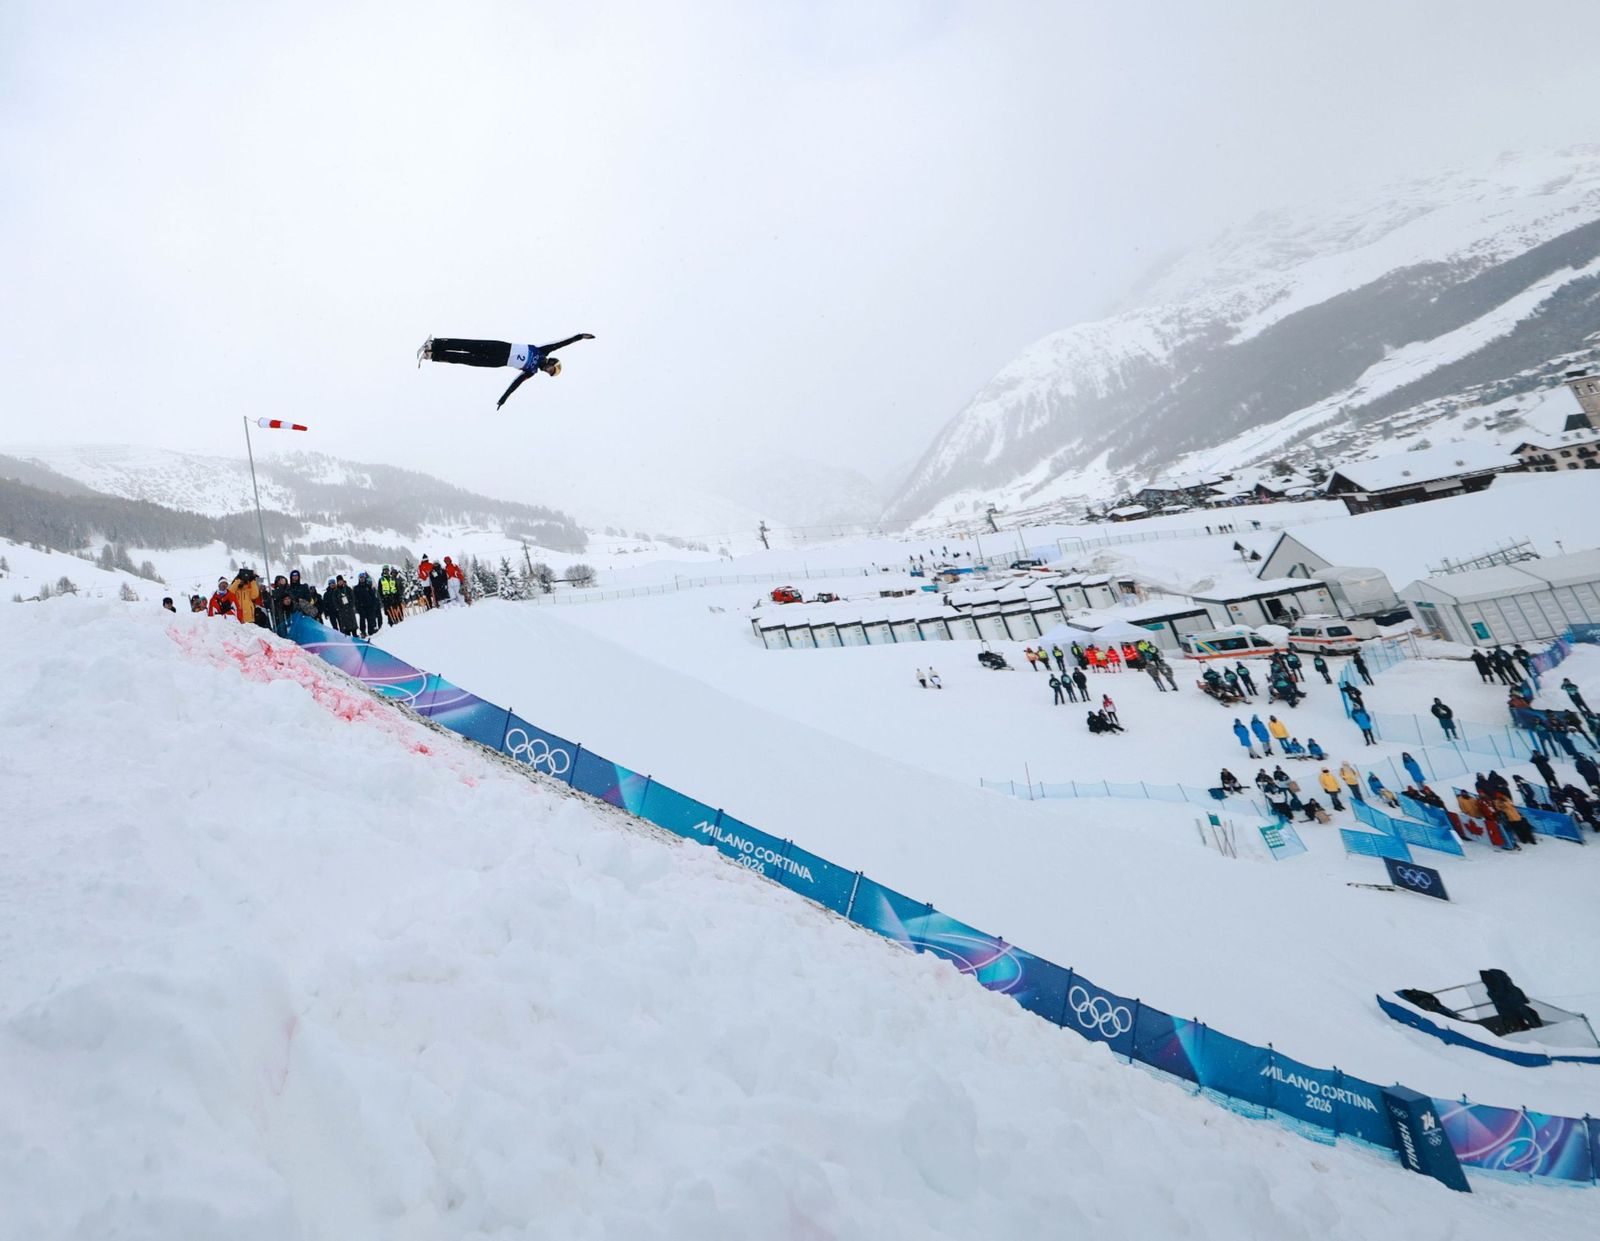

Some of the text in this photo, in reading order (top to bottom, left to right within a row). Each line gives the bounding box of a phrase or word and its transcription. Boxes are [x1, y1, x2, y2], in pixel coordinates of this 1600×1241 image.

[516, 354, 526, 362] 2
[693, 820, 815, 884] MILANO CORTINA
[737, 853, 765, 875] 2026
[1260, 1065, 1379, 1114] MILANO CORTINA
[1305, 1094, 1333, 1114] 2026
[1397, 1120, 1421, 1170] FINISH
